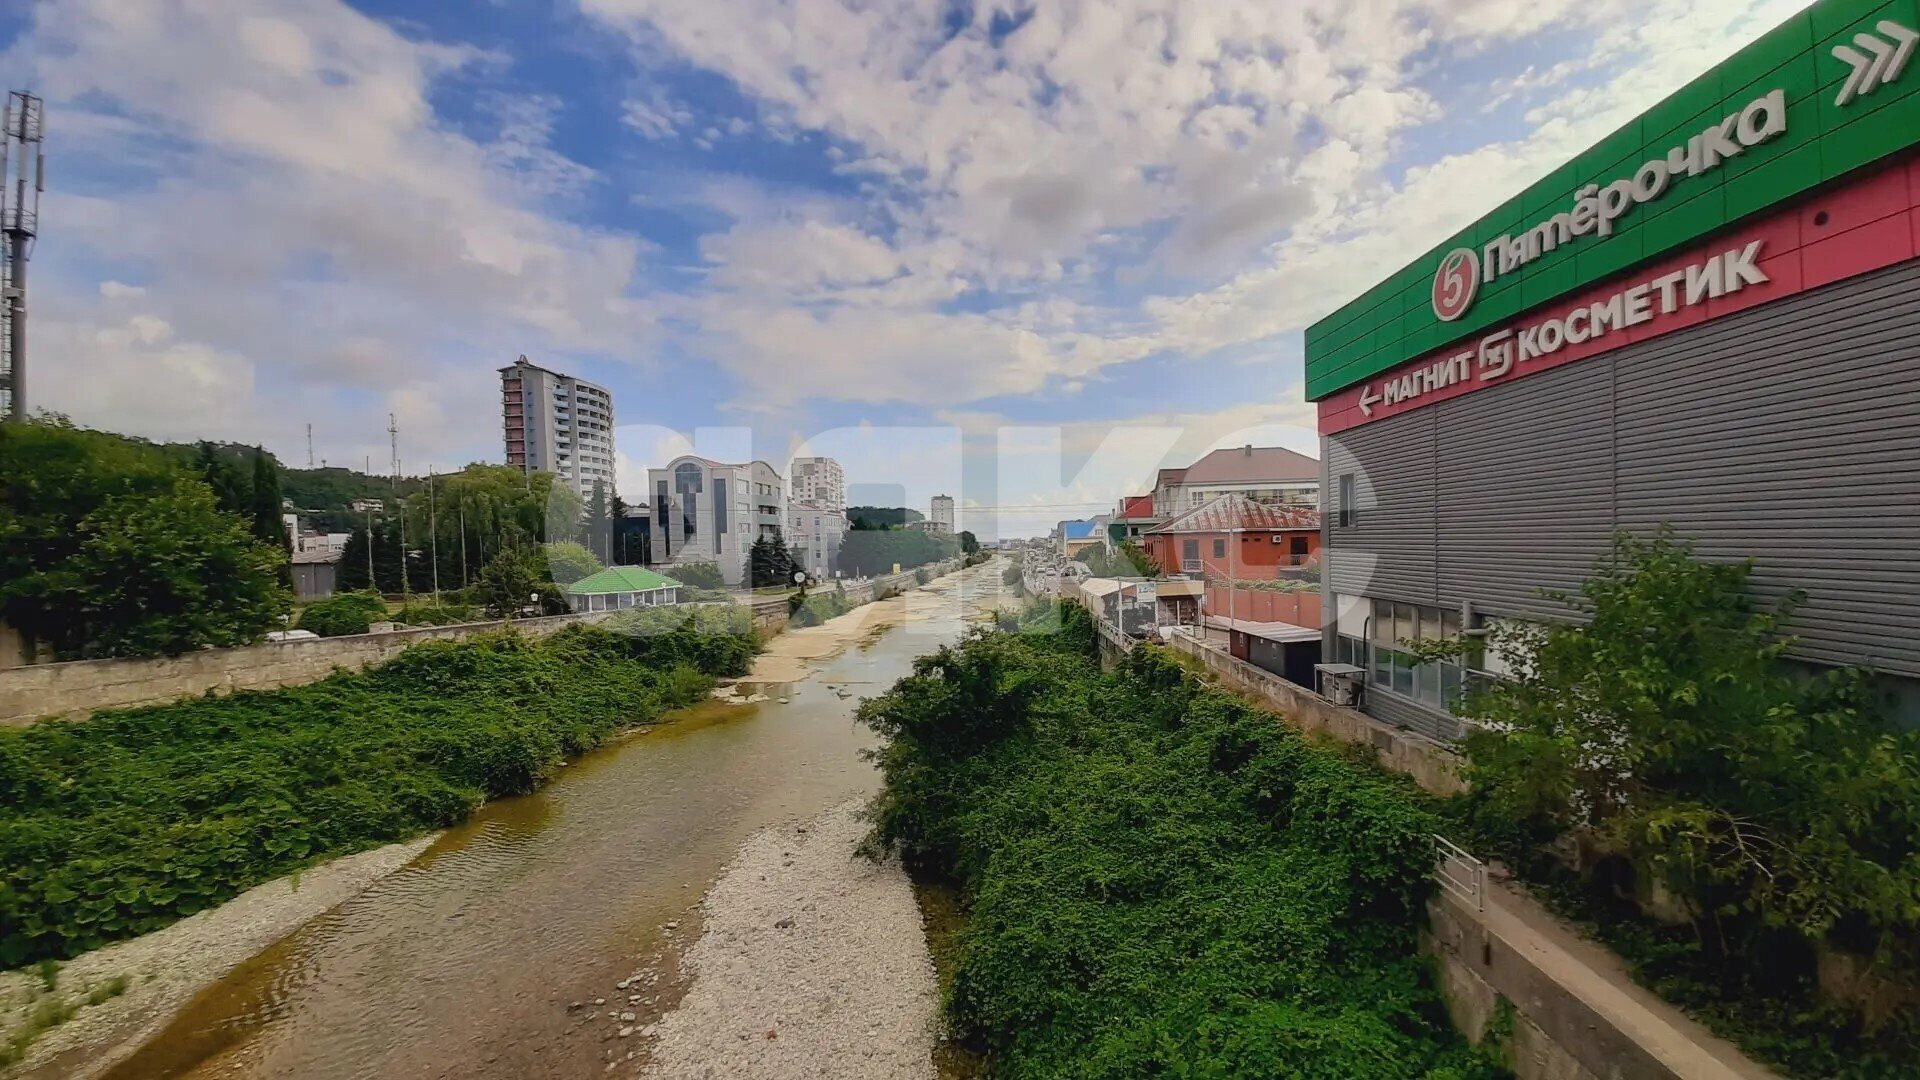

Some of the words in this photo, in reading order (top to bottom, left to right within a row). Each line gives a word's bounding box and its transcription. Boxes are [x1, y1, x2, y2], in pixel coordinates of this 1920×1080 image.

[1483, 89, 1787, 283] Пятёрочка
[1383, 350, 1475, 406] МАГНИТ
[1518, 239, 1769, 362] КОСМЕТИК
